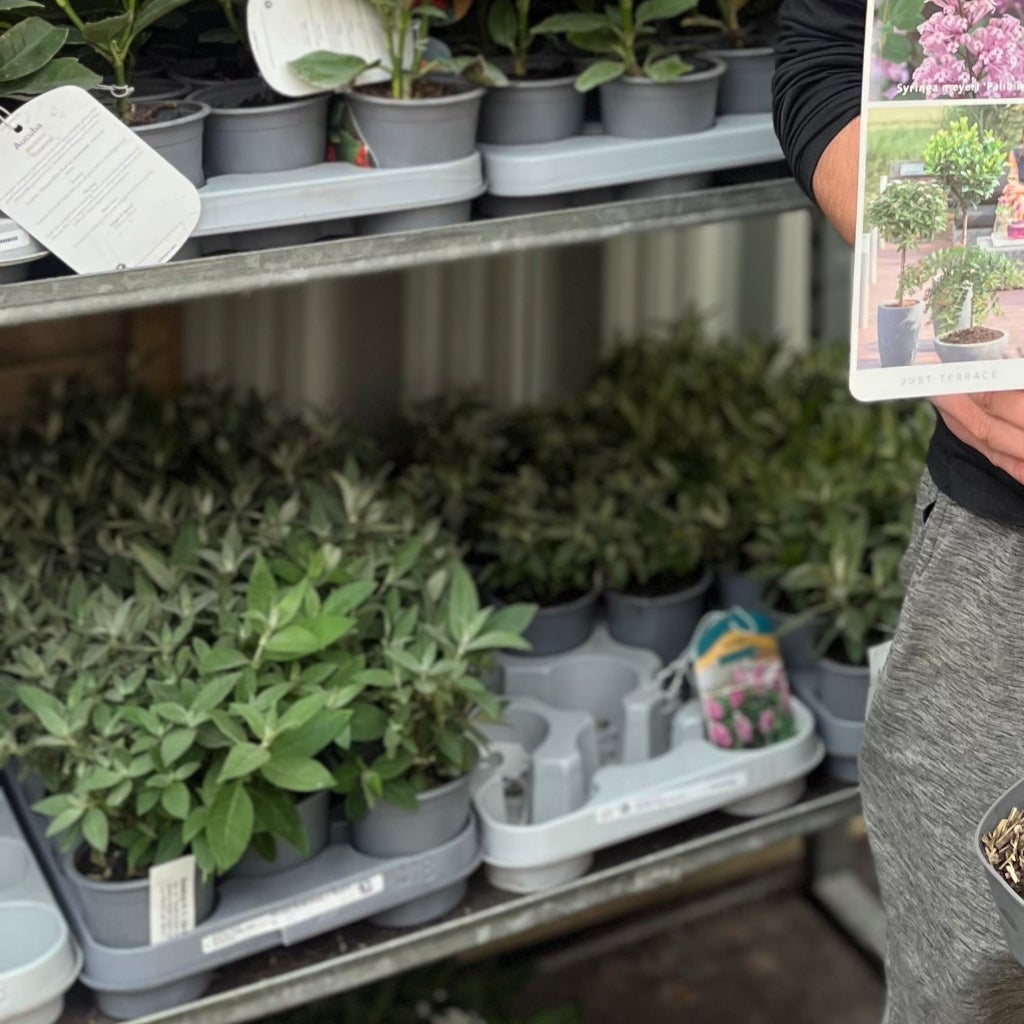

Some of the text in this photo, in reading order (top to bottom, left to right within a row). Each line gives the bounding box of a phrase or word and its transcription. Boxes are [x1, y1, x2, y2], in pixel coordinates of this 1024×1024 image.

[896, 83, 937, 95] Syringa
[14, 123, 43, 150] Aucuba
[901, 370, 998, 386] JUST TERRACE
